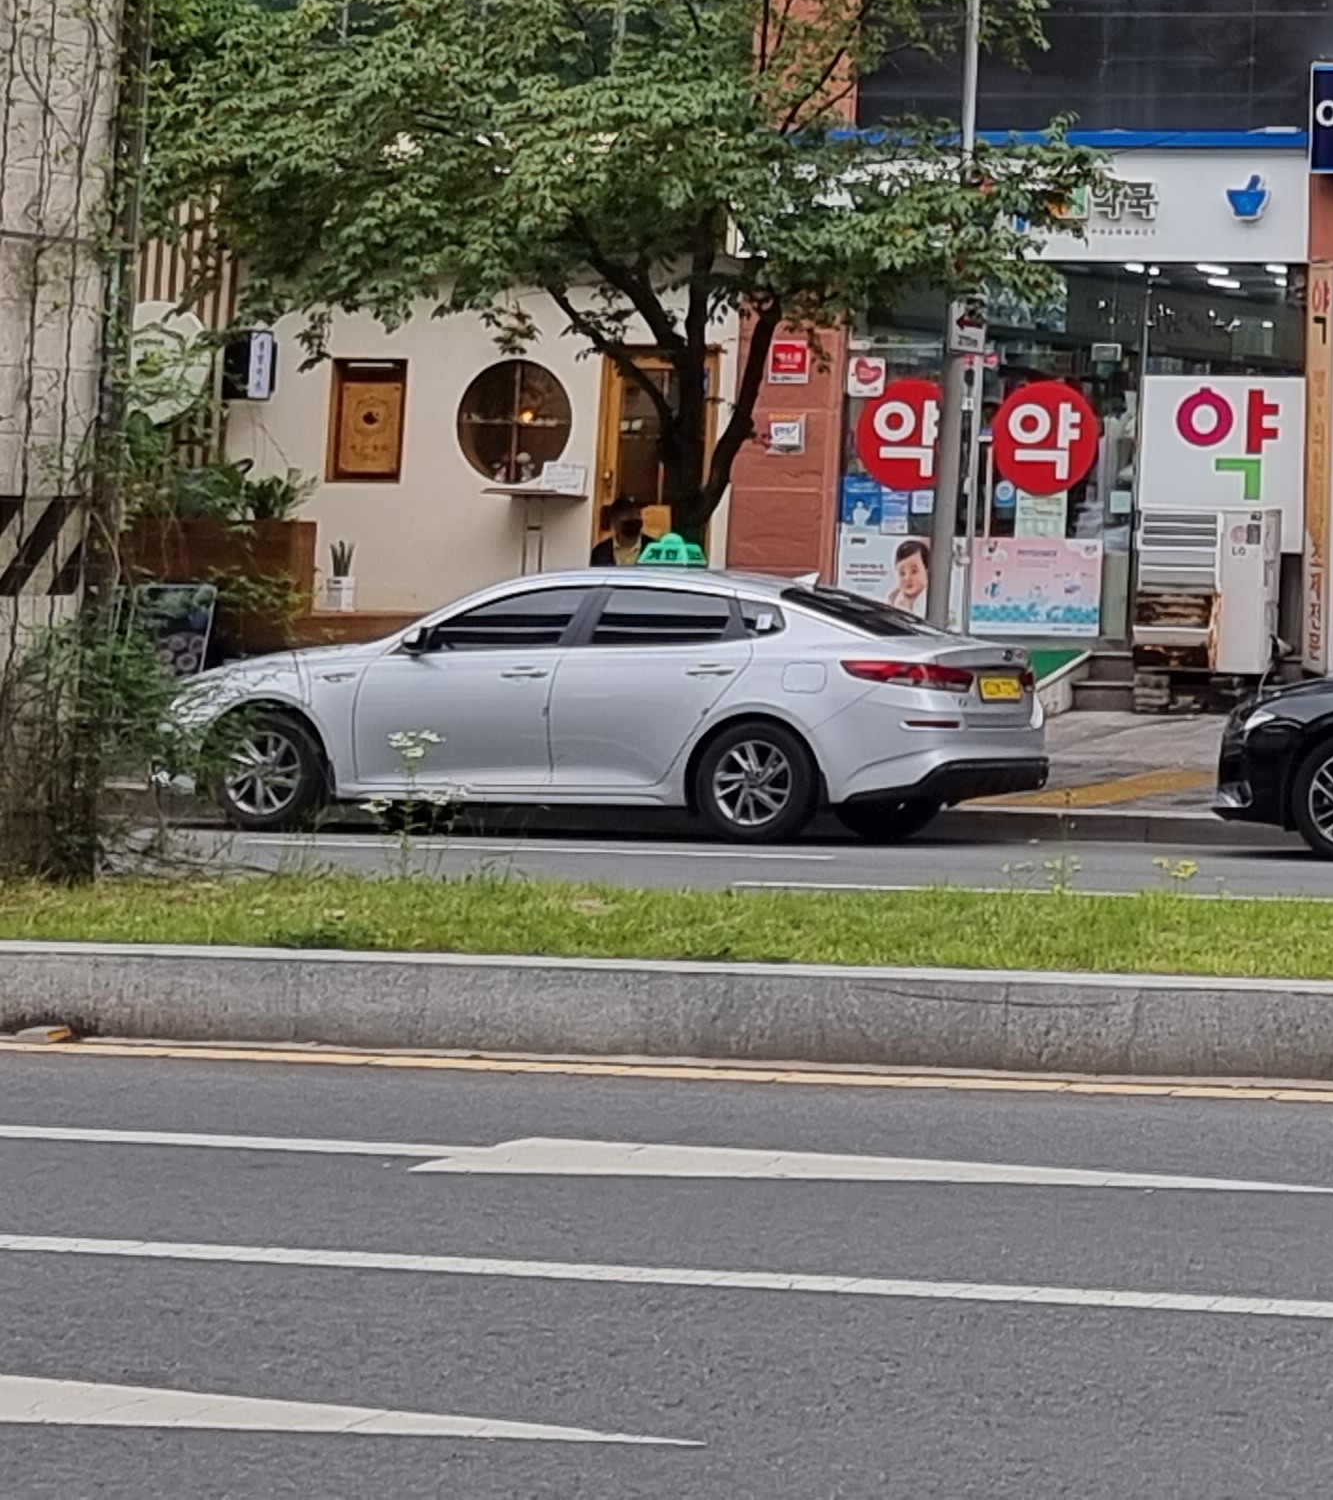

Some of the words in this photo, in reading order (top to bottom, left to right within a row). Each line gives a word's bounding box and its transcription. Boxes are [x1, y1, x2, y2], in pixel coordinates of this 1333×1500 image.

[873, 399, 940, 479] 약
[1008, 403, 1081, 480] 약
[1176, 387, 1280, 500] 약
